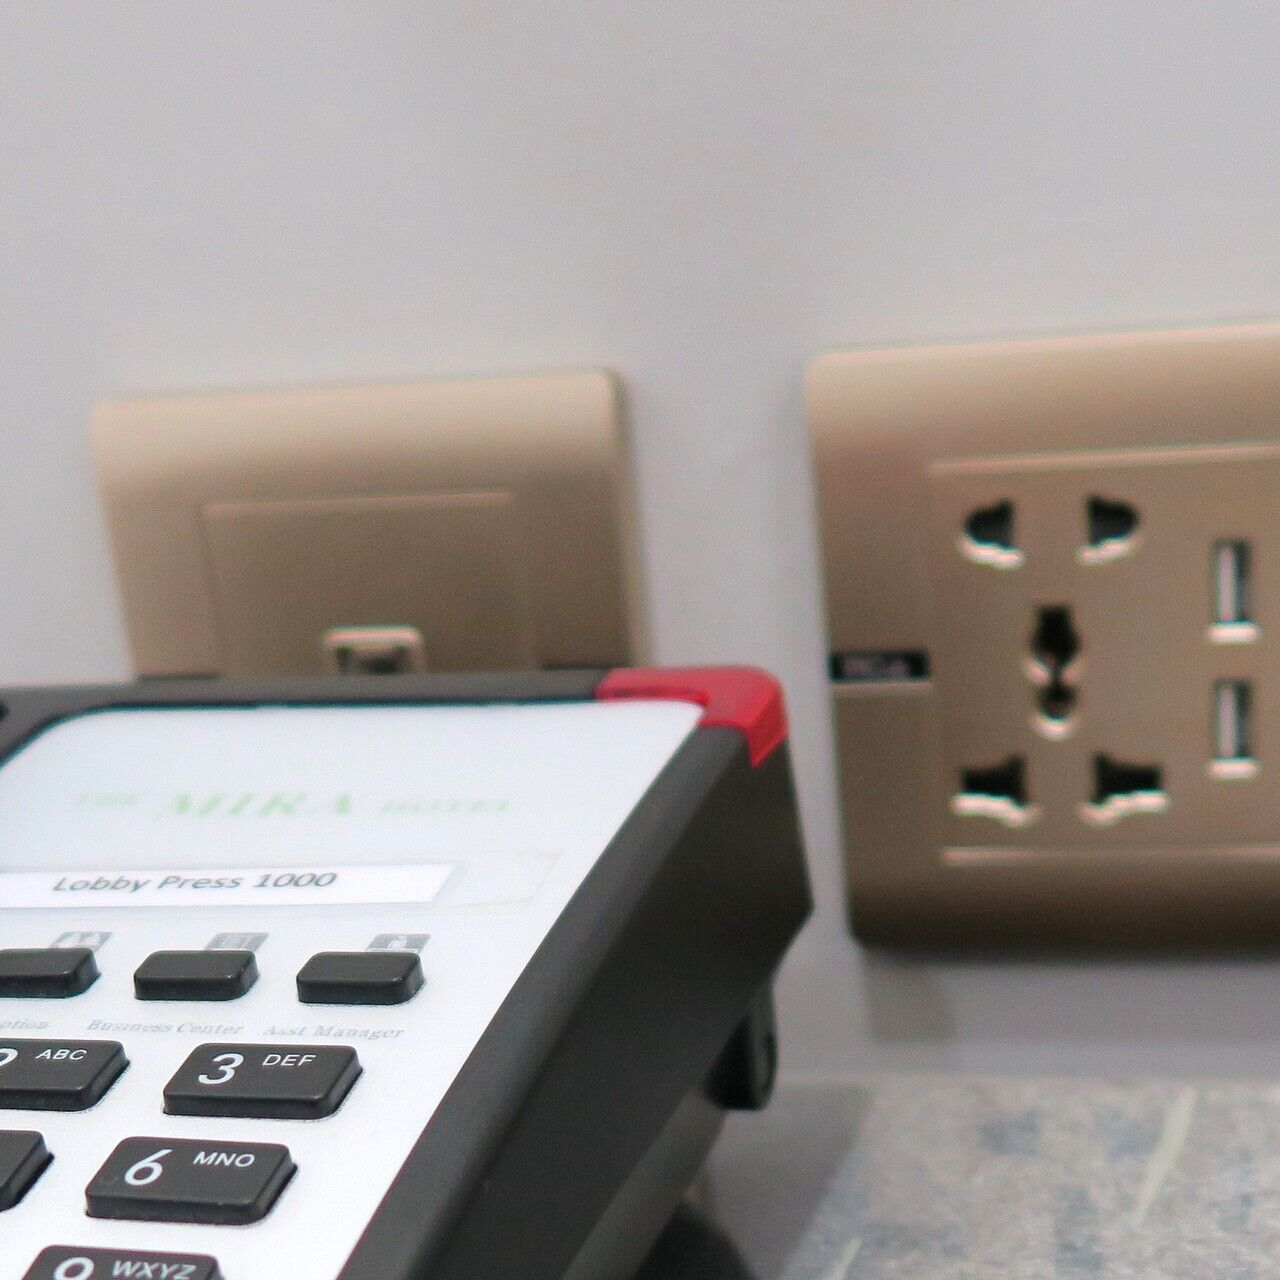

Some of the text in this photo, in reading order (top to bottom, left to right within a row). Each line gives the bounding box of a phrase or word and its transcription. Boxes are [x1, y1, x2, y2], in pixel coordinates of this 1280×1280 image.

[54, 872, 338, 892] Lobby Press 1000
[86, 1018, 245, 1034] Business Center
[312, 1026, 406, 1041] Manager
[35, 1048, 88, 1061] ABC
[198, 1053, 317, 1084] 3 DEF
[124, 1149, 256, 1185] 6 MNO
